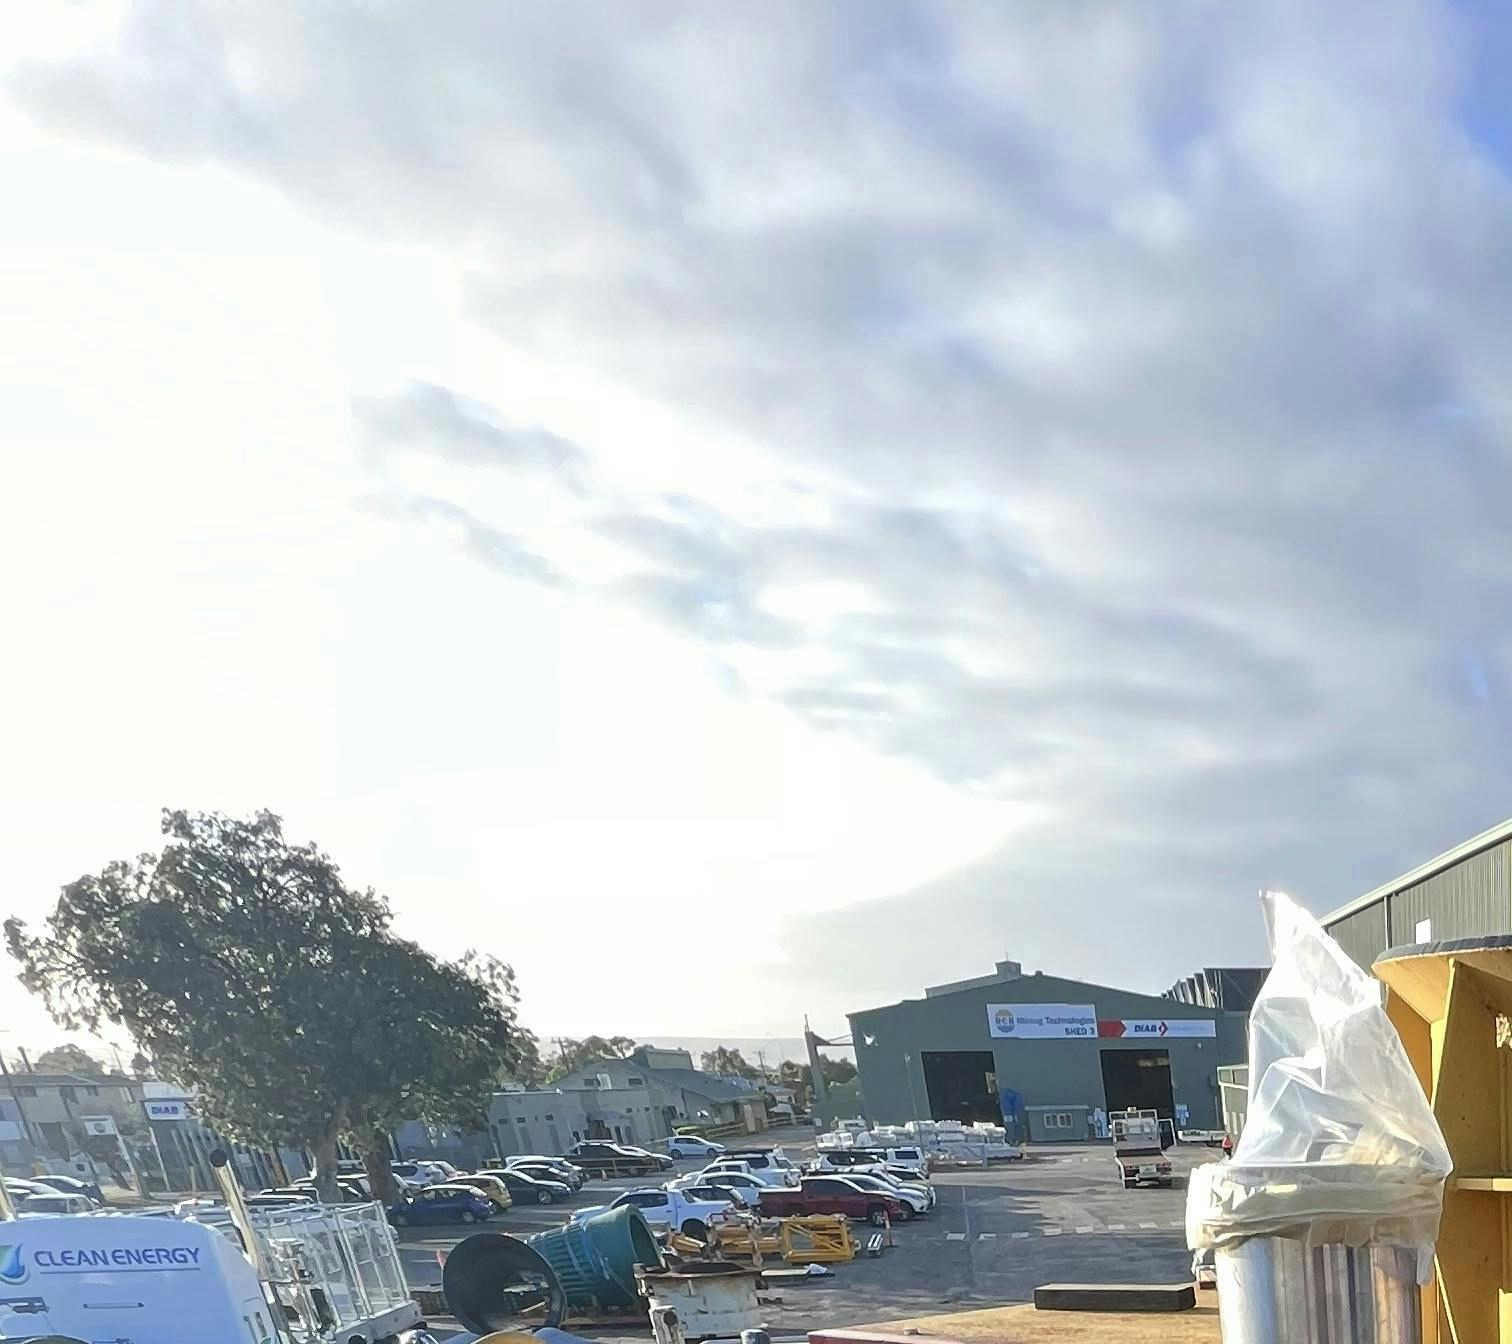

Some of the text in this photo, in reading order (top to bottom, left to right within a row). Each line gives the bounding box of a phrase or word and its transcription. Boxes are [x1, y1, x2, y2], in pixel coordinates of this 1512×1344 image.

[1065, 1027, 1088, 1036] SHED
[34, 1247, 200, 1267] CLEAN ENERGY
